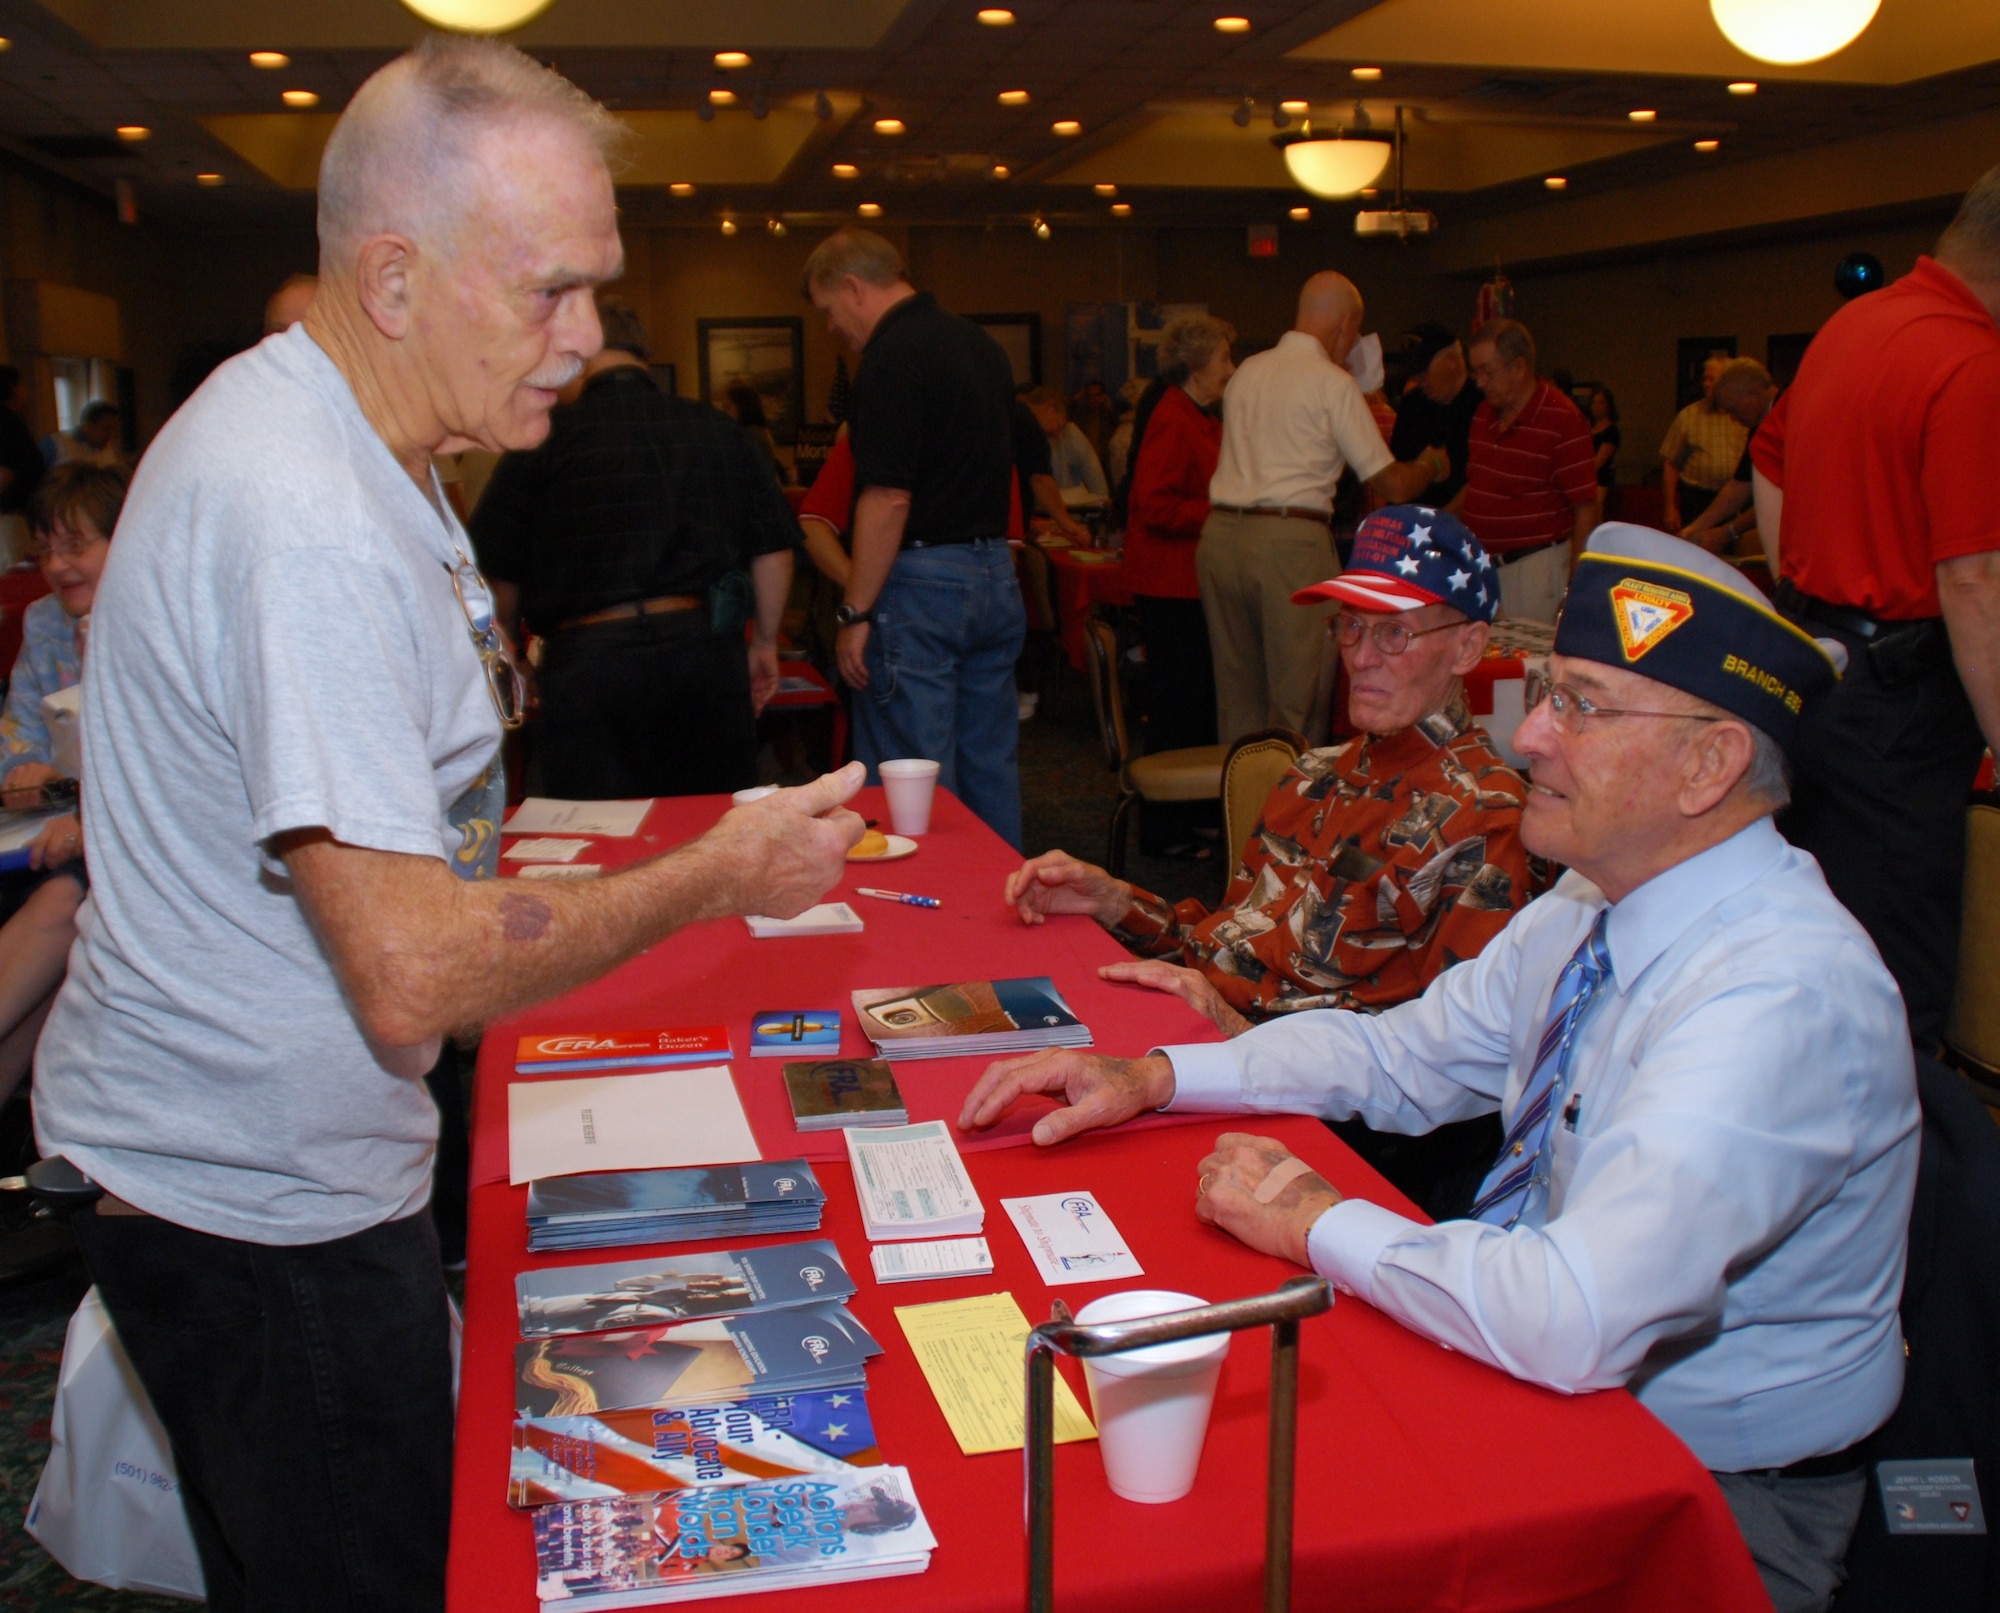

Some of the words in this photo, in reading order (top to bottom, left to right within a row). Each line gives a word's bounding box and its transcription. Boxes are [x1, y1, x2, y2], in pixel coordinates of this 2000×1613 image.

[1634, 593, 1672, 609] LOYALTY
[1723, 653, 1787, 699] BRANCH
[553, 1039, 617, 1051] FRA
[658, 1035, 709, 1044] Baker's
[658, 1042, 704, 1050] Dozen
[1068, 1201, 1094, 1218] FRA
[804, 1269, 825, 1286] FRA
[807, 1339, 829, 1356] FRA
[653, 1411, 686, 1426] &
[724, 1402, 755, 1444] Your
[758, 1396, 793, 1432] FRA
[651, 1432, 689, 1460] Ally
[688, 1408, 727, 1480] Advocate
[115, 1460, 147, 1485] (501)
[563, 1505, 573, 1525] and
[582, 1503, 592, 1519] out
[708, 1488, 741, 1540] than
[739, 1486, 780, 1557] Louder
[768, 1483, 817, 1550] Speak
[805, 1481, 848, 1556] Actions
[582, 1520, 593, 1535] for
[675, 1491, 715, 1559] Words
[563, 1527, 575, 1567] benefits
[580, 1536, 592, 1558] your
